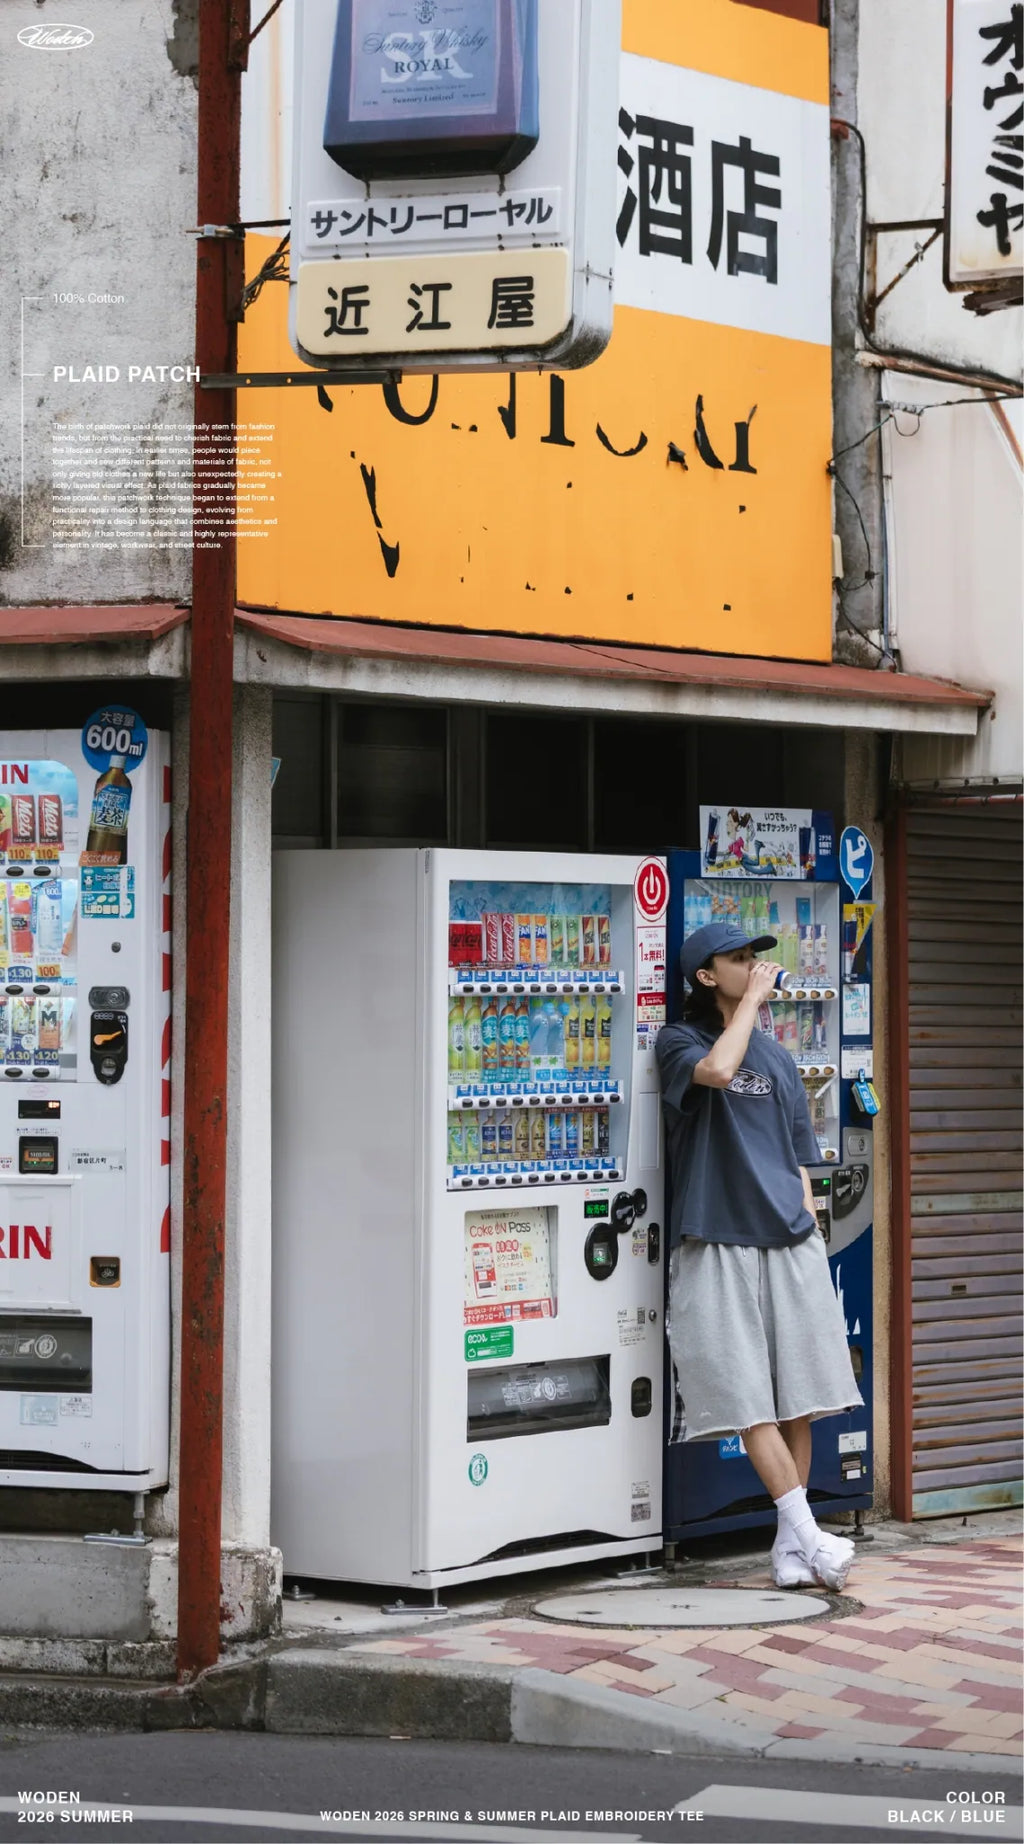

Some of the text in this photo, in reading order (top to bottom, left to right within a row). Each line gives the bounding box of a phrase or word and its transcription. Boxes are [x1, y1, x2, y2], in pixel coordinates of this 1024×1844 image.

[394, 57, 454, 74] ROYAL
[616, 106, 782, 285] 酒店
[310, 197, 553, 238] サントリーローヤル
[323, 275, 536, 337] 近江屋
[100, 711, 135, 727] 大容量
[86, 724, 143, 756] 600ml
[17, 799, 33, 837] Mets
[43, 799, 59, 837] Mets
[469, 1224, 493, 1238] Coke
[508, 1221, 531, 1233] Pass
